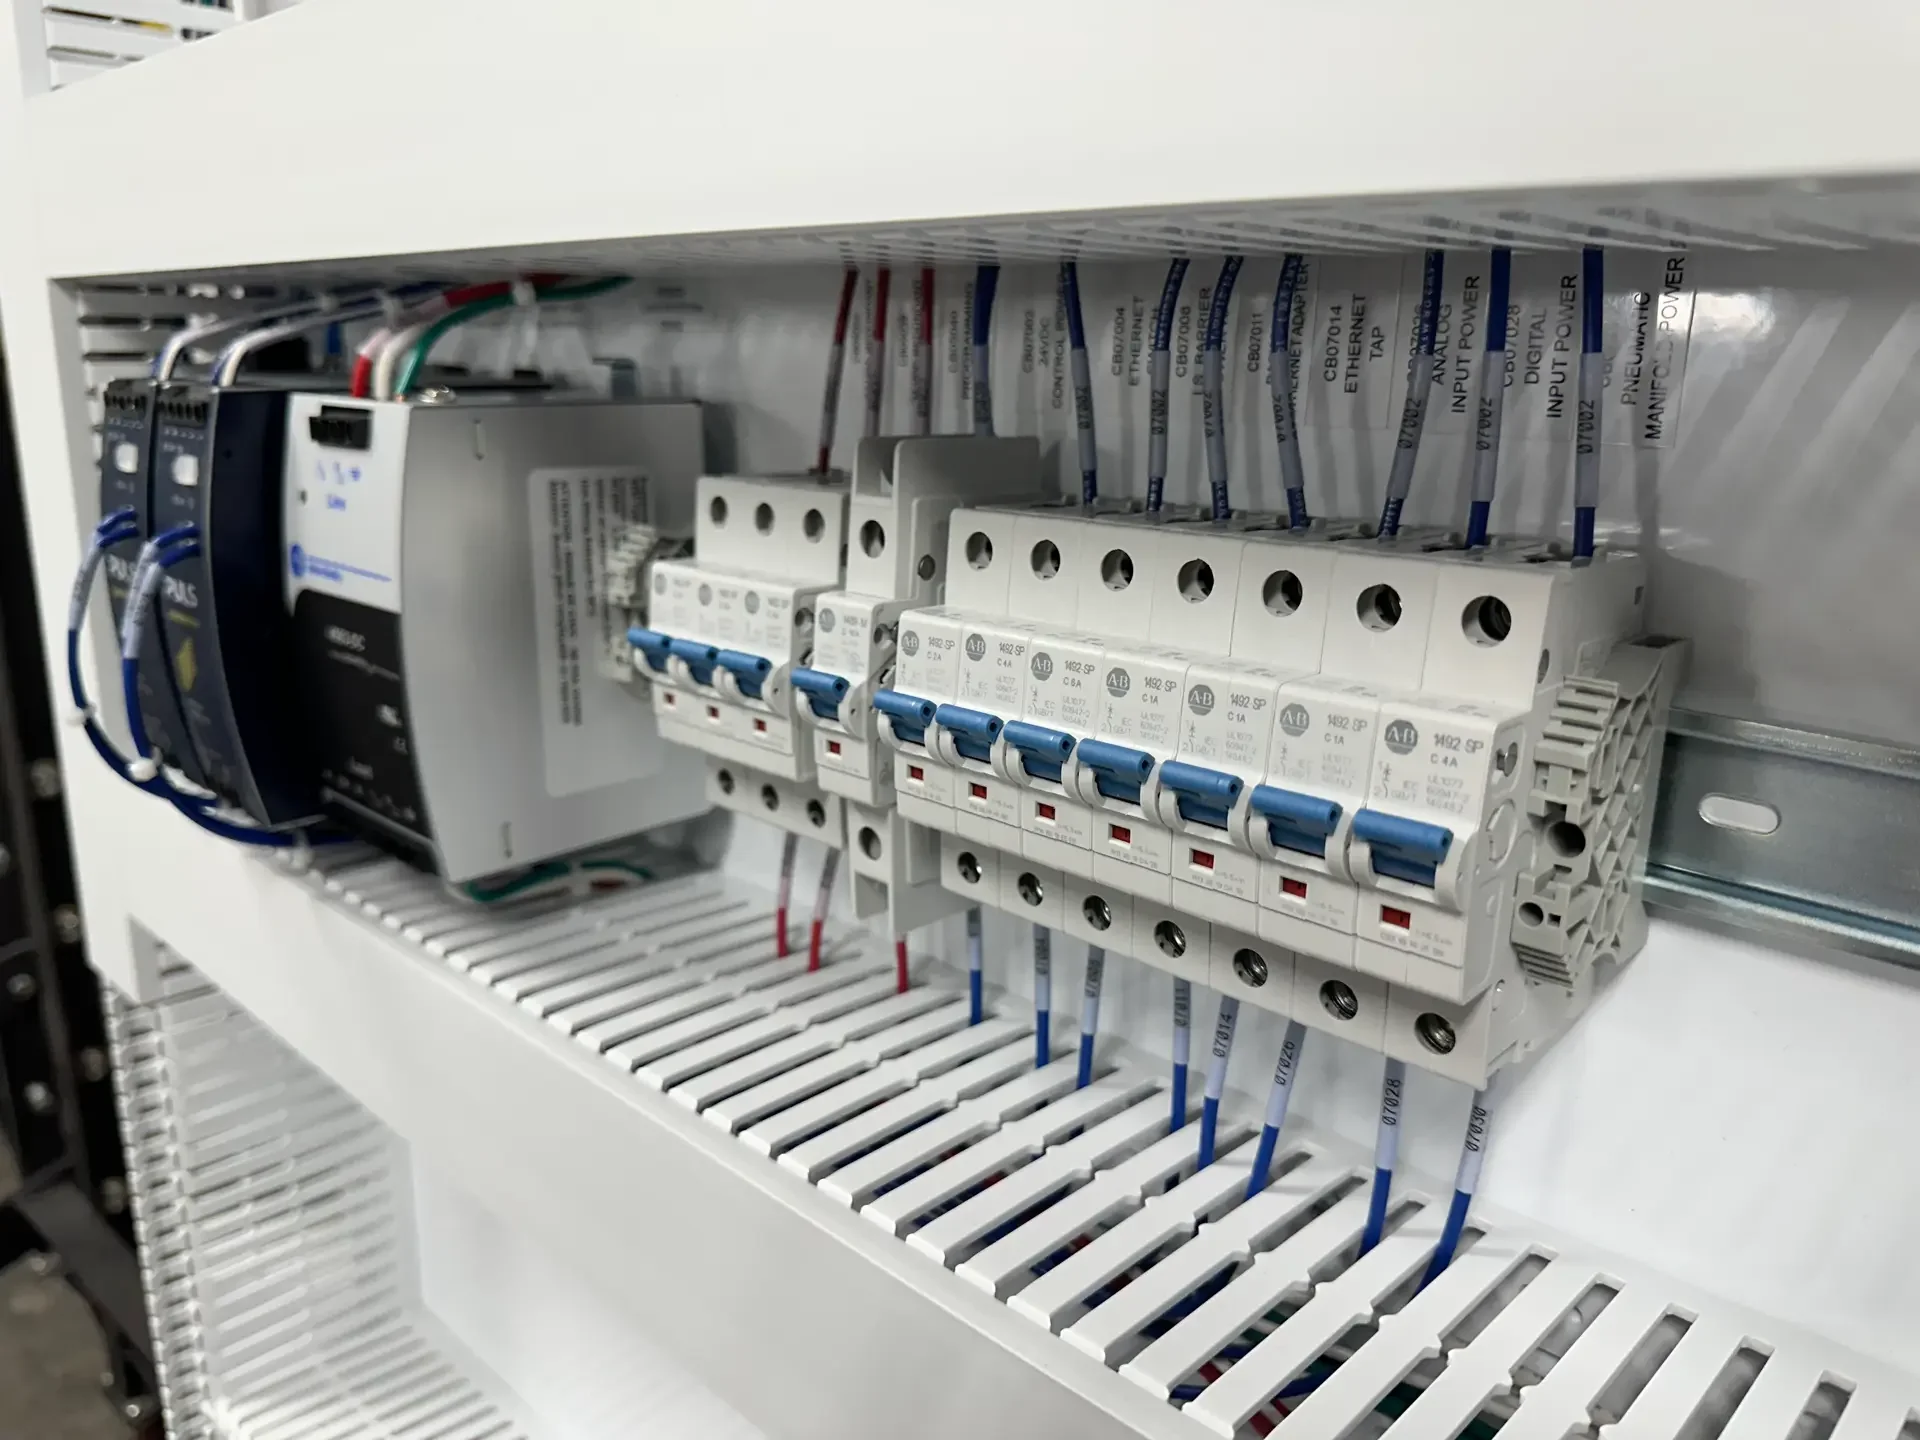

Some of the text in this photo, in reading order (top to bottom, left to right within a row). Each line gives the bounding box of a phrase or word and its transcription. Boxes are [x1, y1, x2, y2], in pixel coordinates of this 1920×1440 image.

[1659, 257, 1685, 332] POWER
[1112, 307, 1125, 376] CB07004
[1128, 296, 1145, 387] ETHERNET
[1247, 312, 1263, 373] CB07011
[1324, 305, 1342, 382] CB07014
[1344, 294, 1366, 393] ETHERNET
[1369, 326, 1385, 362] TAP
[1431, 304, 1452, 385] ANALOG
[1452, 276, 1480, 413] INPUT POWER
[1524, 308, 1547, 384] DIGITAL
[1546, 275, 1578, 418] INPUT POWER
[1052, 340, 1065, 409] CONTROL
[1397, 398, 1421, 450] 07002
[1475, 397, 1493, 450] 07002
[1576, 400, 1595, 455] 07002
[1003, 659, 1012, 668] 4A
[1150, 695, 1159, 706] 1A
[1236, 713, 1246, 723] 1A
[1334, 734, 1344, 745] 1A
[1442, 756, 1458, 767] 4A
[1213, 1012, 1232, 1058] 07014
[1275, 1041, 1296, 1086] 07026
[1382, 1078, 1403, 1126] 07028
[1465, 1106, 1487, 1152] 07030
